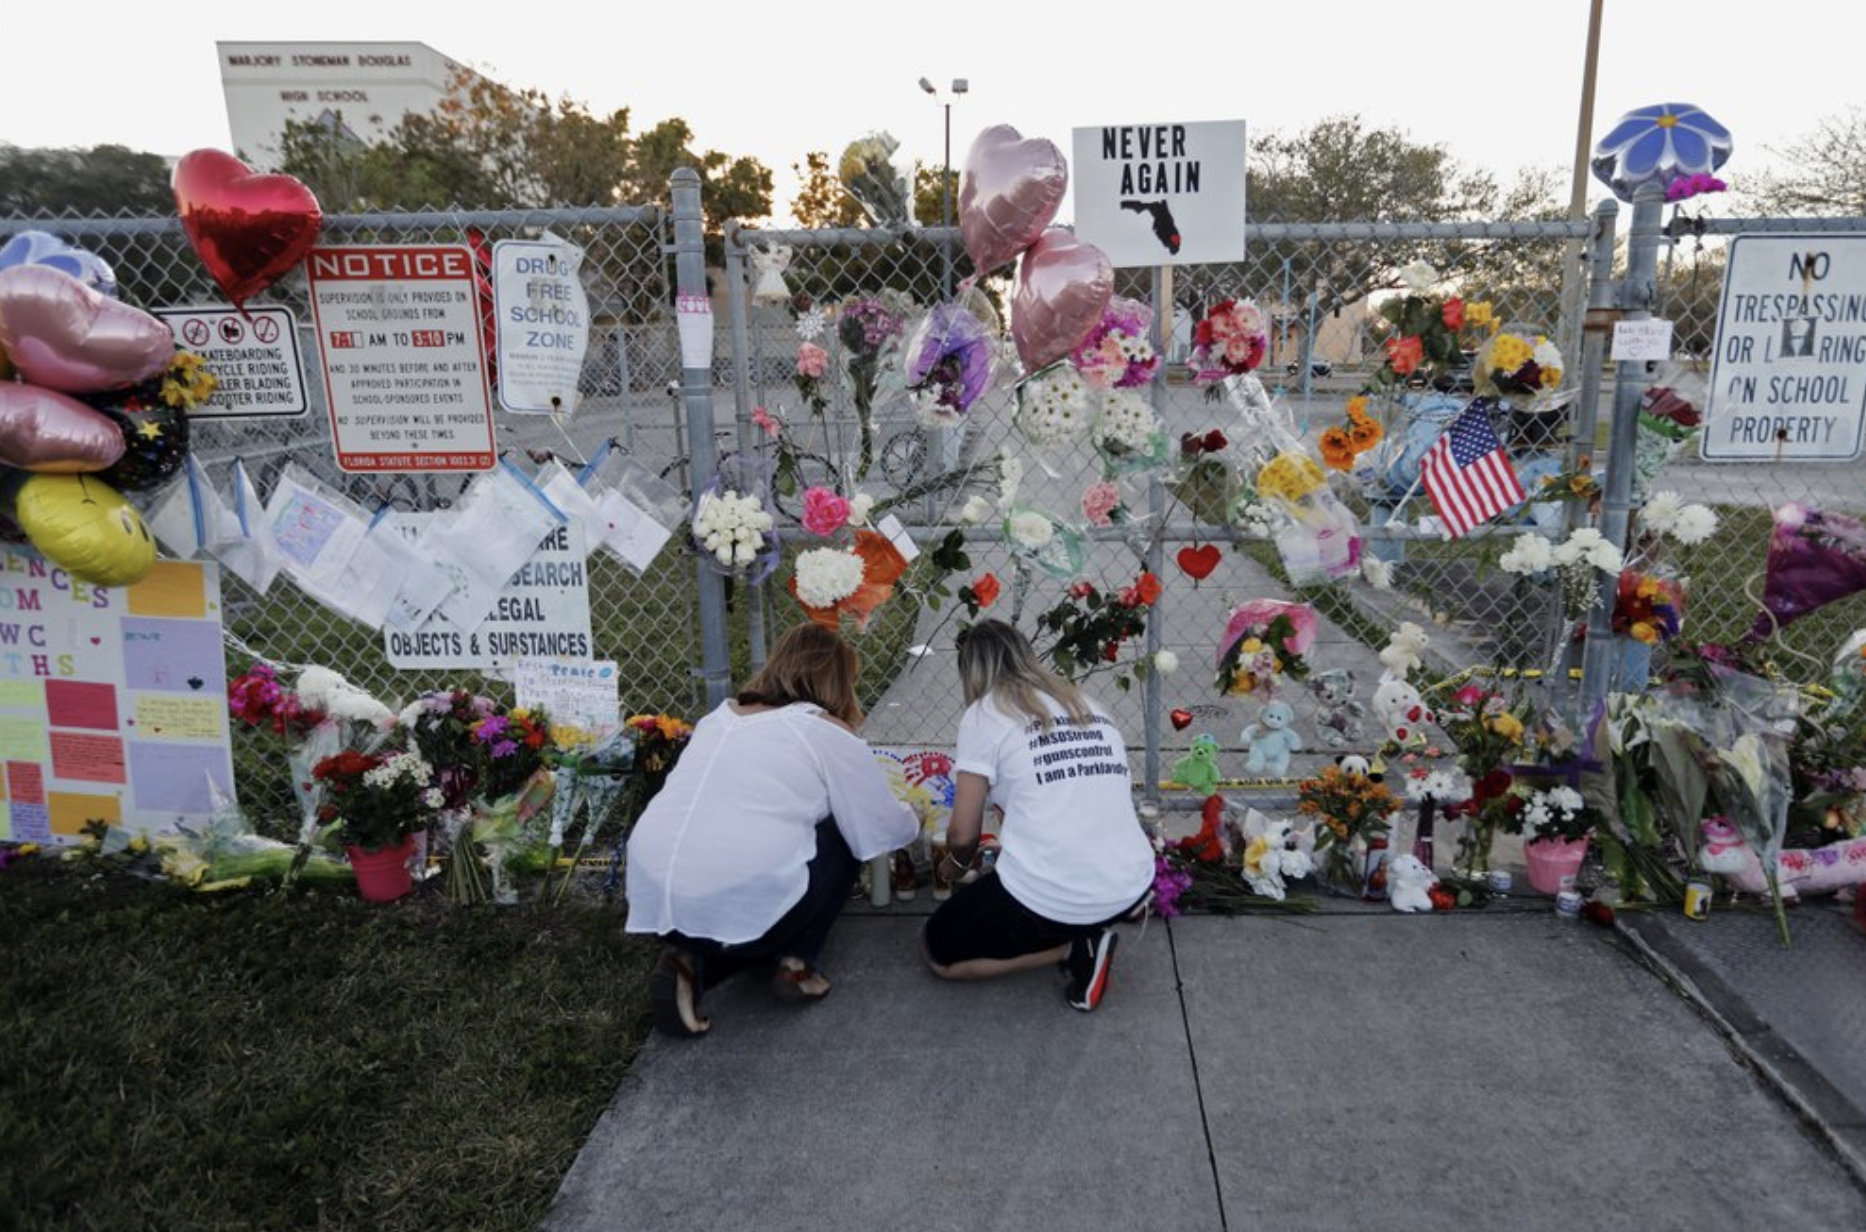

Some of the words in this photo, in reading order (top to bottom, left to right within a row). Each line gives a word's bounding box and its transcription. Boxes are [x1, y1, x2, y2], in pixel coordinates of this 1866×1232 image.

[228, 56, 281, 67] MARJORY
[291, 56, 350, 67] STONEMAN
[358, 56, 412, 67] DOUGLAS
[280, 91, 308, 102] HIGH
[317, 91, 368, 102] SCHOOL
[1102, 125, 1186, 160] NEVER
[1120, 161, 1200, 195] AGAIN
[314, 253, 466, 277] NOTICE
[1788, 251, 1831, 281] NO
[319, 292, 372, 304] SUPERVISION
[388, 292, 408, 303] ONLY
[412, 291, 451, 303] PROVIDED
[455, 291, 468, 302] ON
[526, 283, 572, 302] FREE
[346, 309, 379, 320] SCHOOL
[382, 309, 419, 320] GROUNDS
[423, 308, 445, 319] FROM
[510, 306, 581, 328] SCHOOL
[368, 333, 387, 346] AM
[392, 333, 408, 346] TO
[415, 331, 441, 346] 3:10
[446, 332, 464, 345] PM
[526, 331, 575, 351] ZONE
[1727, 335, 1754, 363] OR
[248, 362, 288, 375] RIDING
[330, 364, 346, 374] AND
[363, 363, 396, 374] MINUTES
[398, 363, 428, 373] BEFORE
[432, 363, 449, 372] AND
[452, 361, 477, 372] AFTER
[244, 377, 291, 390] BLADING
[351, 379, 392, 389] APPROVED
[395, 378, 449, 388] PARTICIPATION
[453, 378, 462, 387] IN
[1767, 376, 1849, 404] SCHOOL
[255, 391, 294, 404] RIDING
[433, 393, 463, 403] EVENTS
[337, 416, 349, 425] NO
[355, 415, 407, 425] SUPERVISION
[413, 415, 430, 425] WILL
[435, 414, 444, 424] BE
[448, 414, 485, 425] PROVIDED
[370, 430, 400, 440] BEYOND
[405, 430, 428, 440] THESE
[1730, 415, 1836, 443] PROPERTY
[343, 456, 376, 467] FLORIDA
[379, 456, 411, 467] STATUTE
[414, 456, 446, 467] SECTION
[391, 632, 462, 657] OBJECTS
[470, 633, 482, 656] &
[488, 632, 587, 658] SUBSTANCES
[1028, 729, 1104, 751] #MSDStrong
[1044, 768, 1067, 783] am
[1068, 765, 1077, 778] a
